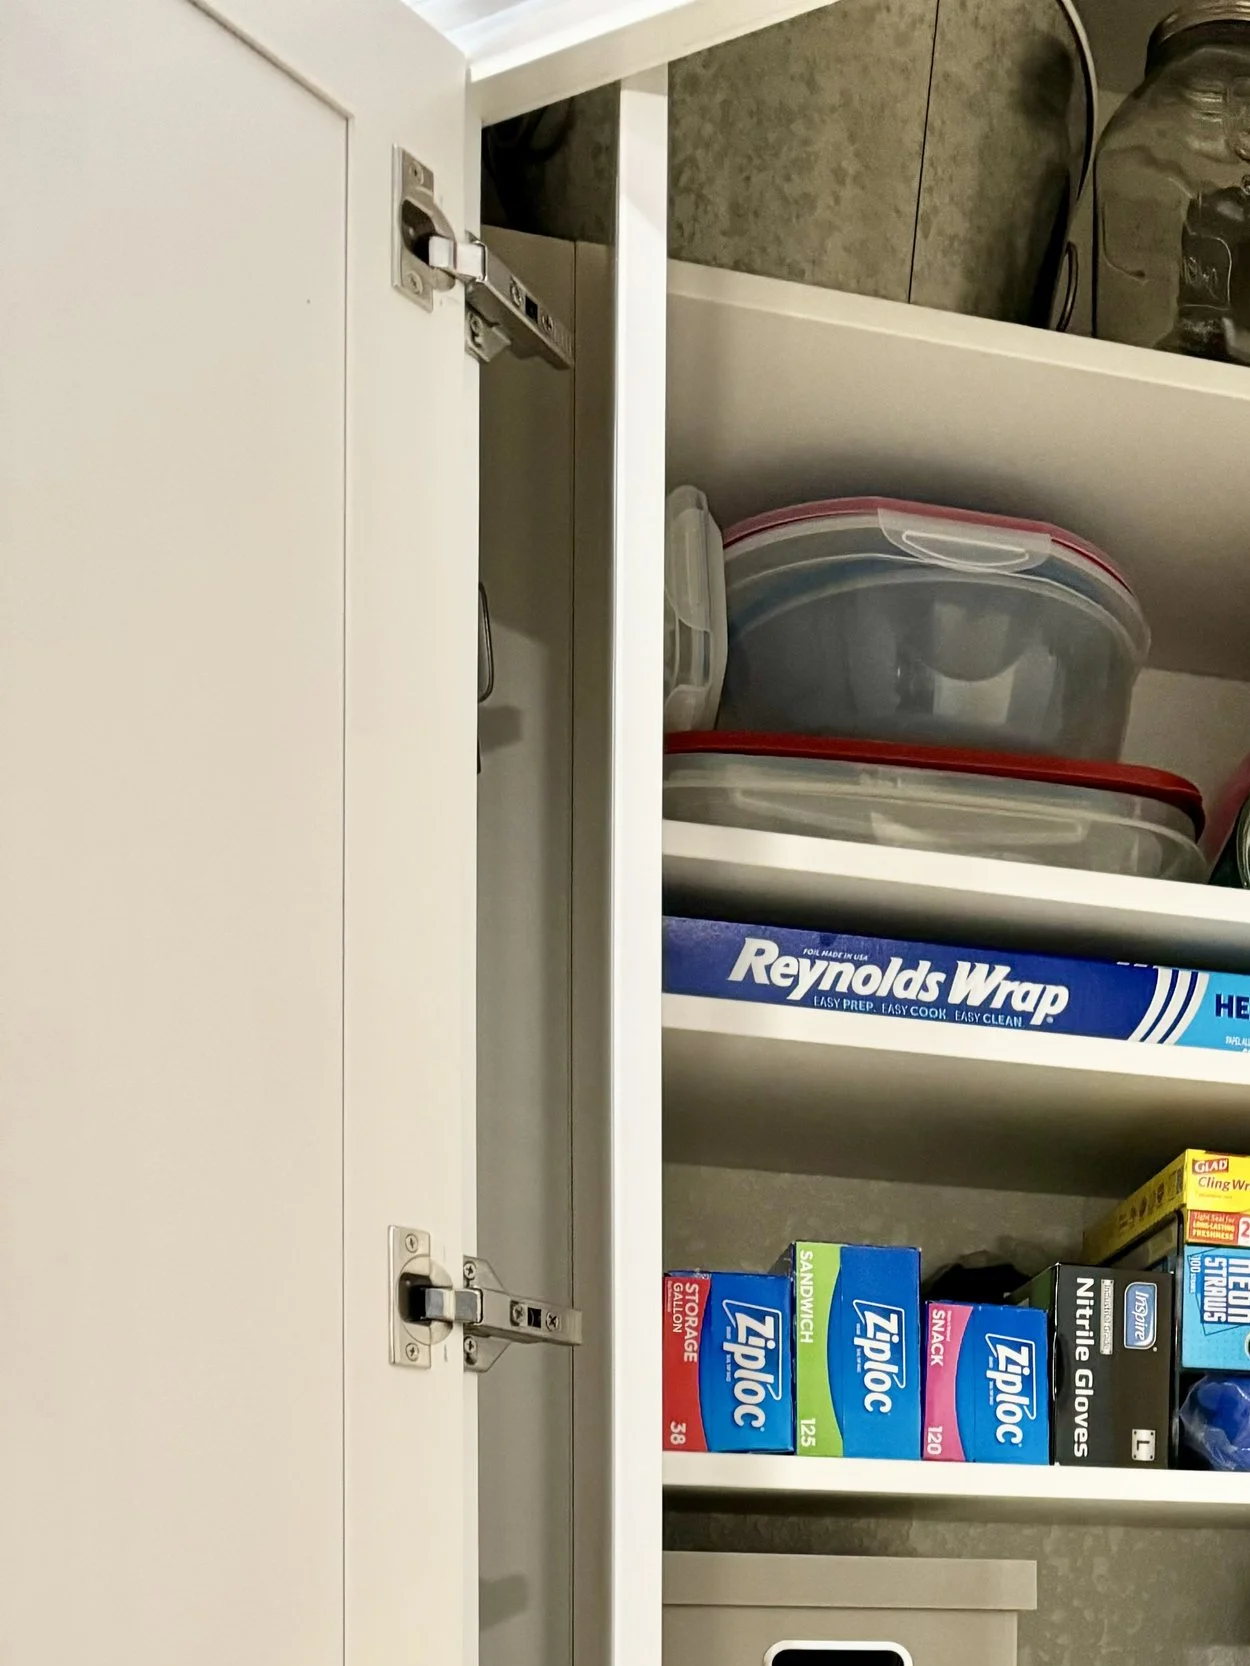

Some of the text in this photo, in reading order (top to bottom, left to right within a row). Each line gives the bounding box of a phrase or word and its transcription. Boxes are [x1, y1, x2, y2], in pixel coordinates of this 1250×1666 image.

[803, 948, 868, 962] FOIL MADE IN USA
[727, 937, 1070, 1026] Reynolds Wrap
[814, 995, 840, 1009] EASY
[843, 998, 876, 1013] PREP.
[882, 1002, 908, 1016] EASY
[955, 1009, 981, 1023] EASY
[1194, 1159, 1228, 1173] GLAD
[1198, 1176, 1231, 1191] Cling
[1190, 1256, 1201, 1273] 100
[672, 1282, 684, 1333] GALLON
[799, 1249, 814, 1343] SANDWICH
[1103, 1284, 1112, 1323] Industrial
[1204, 1257, 1227, 1323] STRAWS
[684, 1282, 699, 1363] STORAGE
[930, 1309, 946, 1366] SNACK
[1134, 1291, 1149, 1341] Inspire
[722, 1312, 776, 1430] Ziploc
[853, 1310, 900, 1414] Ziploc
[1073, 1277, 1095, 1458] Nitrile Gloves
[986, 1343, 1031, 1445] Ziploc
[670, 1421, 686, 1445] 38
[800, 1418, 816, 1447] 125
[927, 1425, 943, 1455] 120
[1136, 1440, 1150, 1451] L
